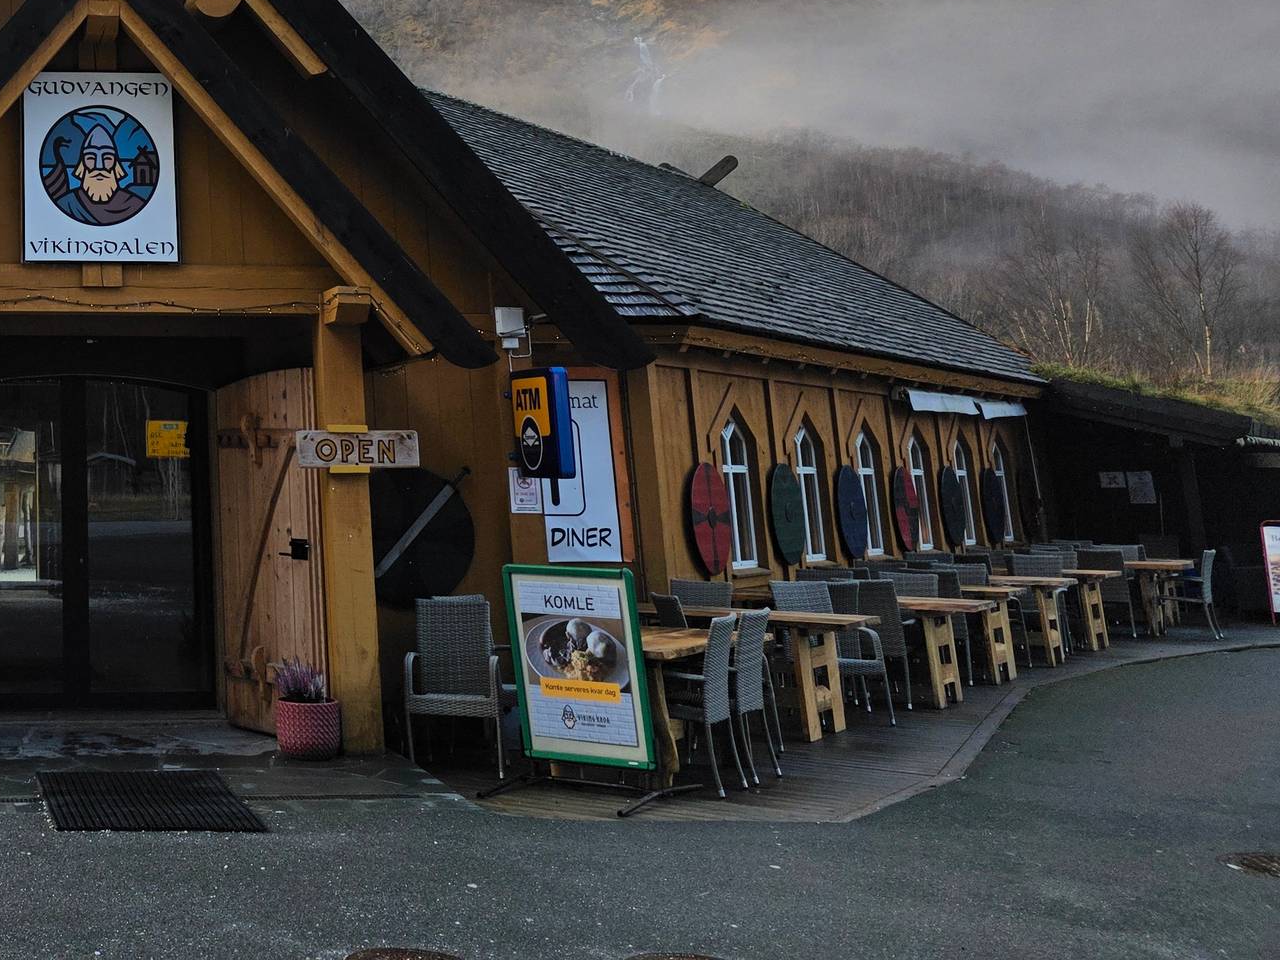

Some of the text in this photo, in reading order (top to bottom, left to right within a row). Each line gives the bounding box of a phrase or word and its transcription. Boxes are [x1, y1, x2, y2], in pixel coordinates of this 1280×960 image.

[516, 387, 541, 411] ATM
[315, 438, 396, 464] OPEN
[551, 527, 612, 548] DINER
[543, 594, 595, 611] KOMLE
[604, 688, 617, 698] dag
